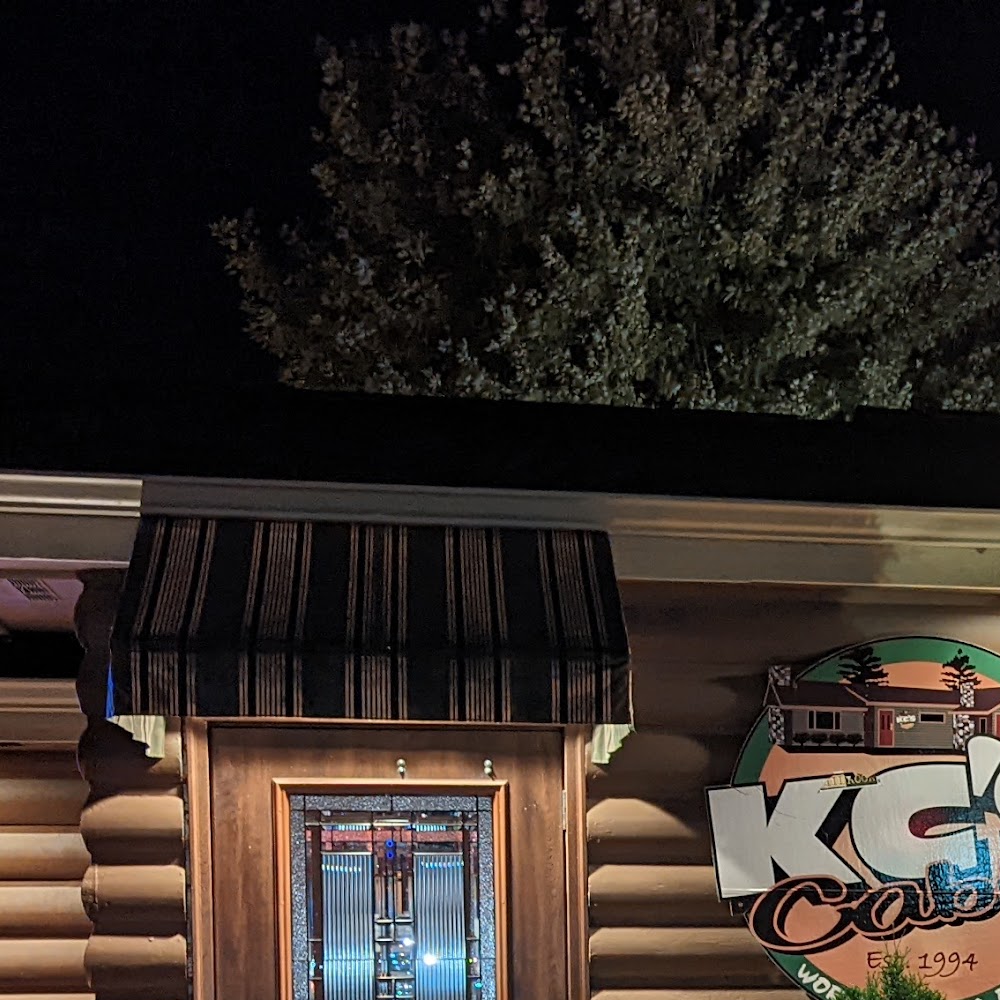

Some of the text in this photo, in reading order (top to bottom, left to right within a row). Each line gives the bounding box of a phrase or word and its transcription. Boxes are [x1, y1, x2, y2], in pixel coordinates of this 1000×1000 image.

[867, 951, 979, 978] Es. 1994
[797, 963, 845, 1000] WOR
